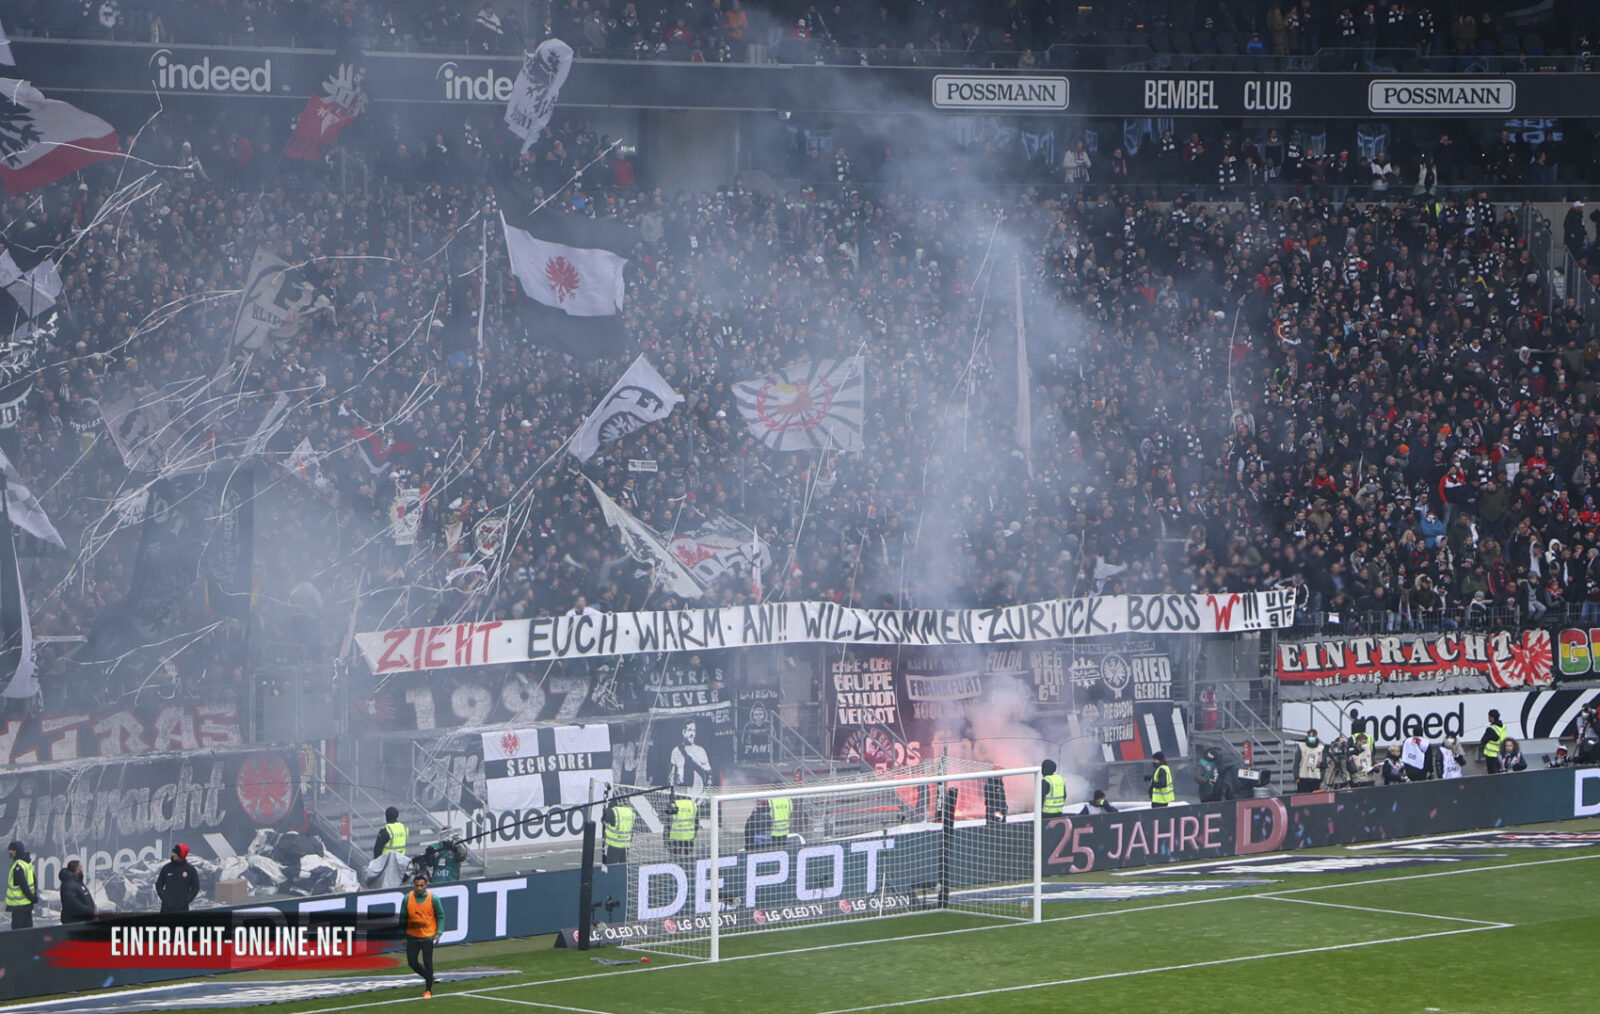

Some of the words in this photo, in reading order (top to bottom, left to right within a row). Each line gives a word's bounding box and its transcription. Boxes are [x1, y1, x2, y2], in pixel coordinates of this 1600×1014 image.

[155, 53, 271, 92] indeed
[442, 64, 514, 101] inde
[947, 83, 1057, 102] POSSMANN
[1144, 80, 1219, 109] BEMBEL
[1244, 81, 1292, 110] CLUB
[1384, 87, 1501, 105] POSSMANN
[376, 621, 503, 674] ZIEHT
[528, 613, 619, 659] EUCH
[634, 607, 725, 651] WARM
[743, 603, 788, 643] AN!!
[801, 602, 976, 644] WILLKOMMEN
[1127, 593, 1200, 631] BOSS
[985, 650, 1023, 672] FULDA
[1280, 630, 1513, 672] EINTRACHT
[649, 668, 724, 686] ULTRAS
[1131, 657, 1172, 682] RIED
[1316, 674, 1341, 687] auf
[1350, 670, 1382, 684] ewig
[1390, 669, 1412, 682] dir
[1418, 665, 1480, 682] ergeben
[833, 672, 894, 691] GRUPPE
[1134, 682, 1172, 699] GEBIET
[405, 672, 593, 730] 1997
[659, 690, 720, 707] NEVER
[507, 753, 592, 777] SECHSDREI
[1047, 817, 1095, 873] 25
[1107, 813, 1222, 860] JAHRE
[637, 838, 895, 921] DEPOT
[765, 910, 780, 922] LG
[782, 906, 809, 919] OLED
[809, 904, 823, 915] TV
[852, 899, 866, 911] LG
[605, 926, 633, 940] OLED
[633, 925, 648, 936] TV
[677, 919, 692, 931] LG
[695, 916, 722, 929] OLD
[723, 914, 737, 925] TV
